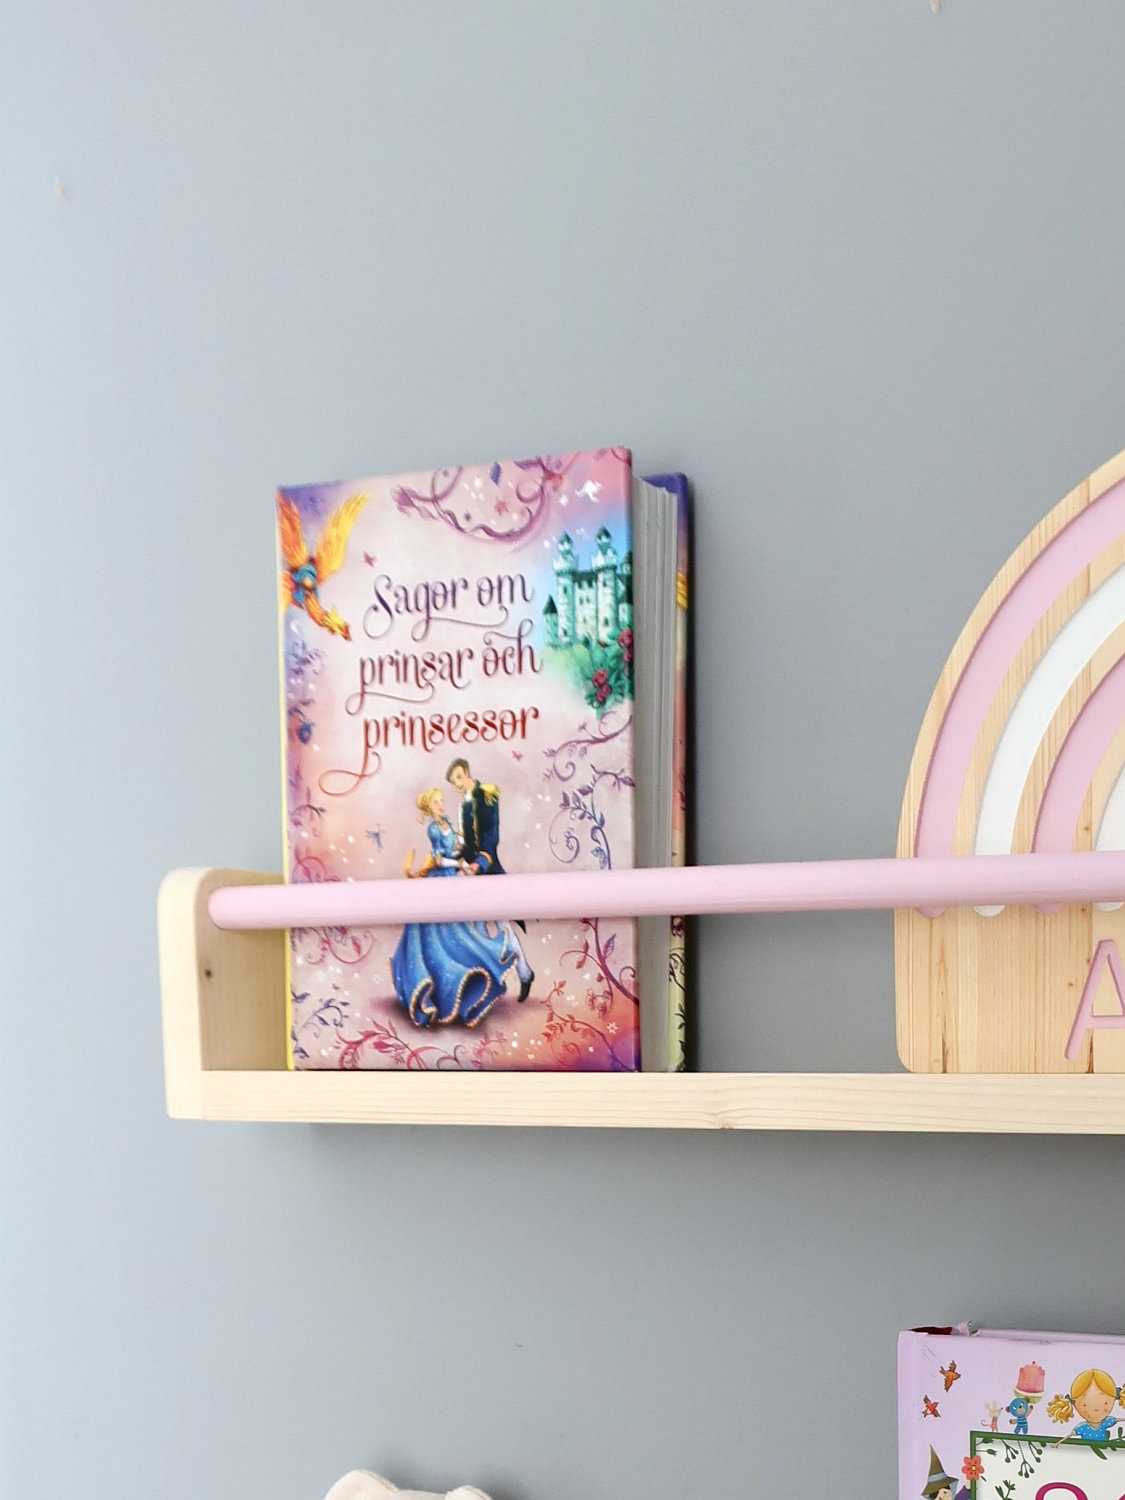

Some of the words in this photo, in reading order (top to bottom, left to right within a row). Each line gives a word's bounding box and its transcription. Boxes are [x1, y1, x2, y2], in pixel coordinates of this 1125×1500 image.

[363, 573, 469, 642] Sagor
[476, 570, 535, 612] om
[345, 645, 473, 717] prinsar
[481, 618, 544, 679] och
[318, 704, 540, 796] prinsessor
